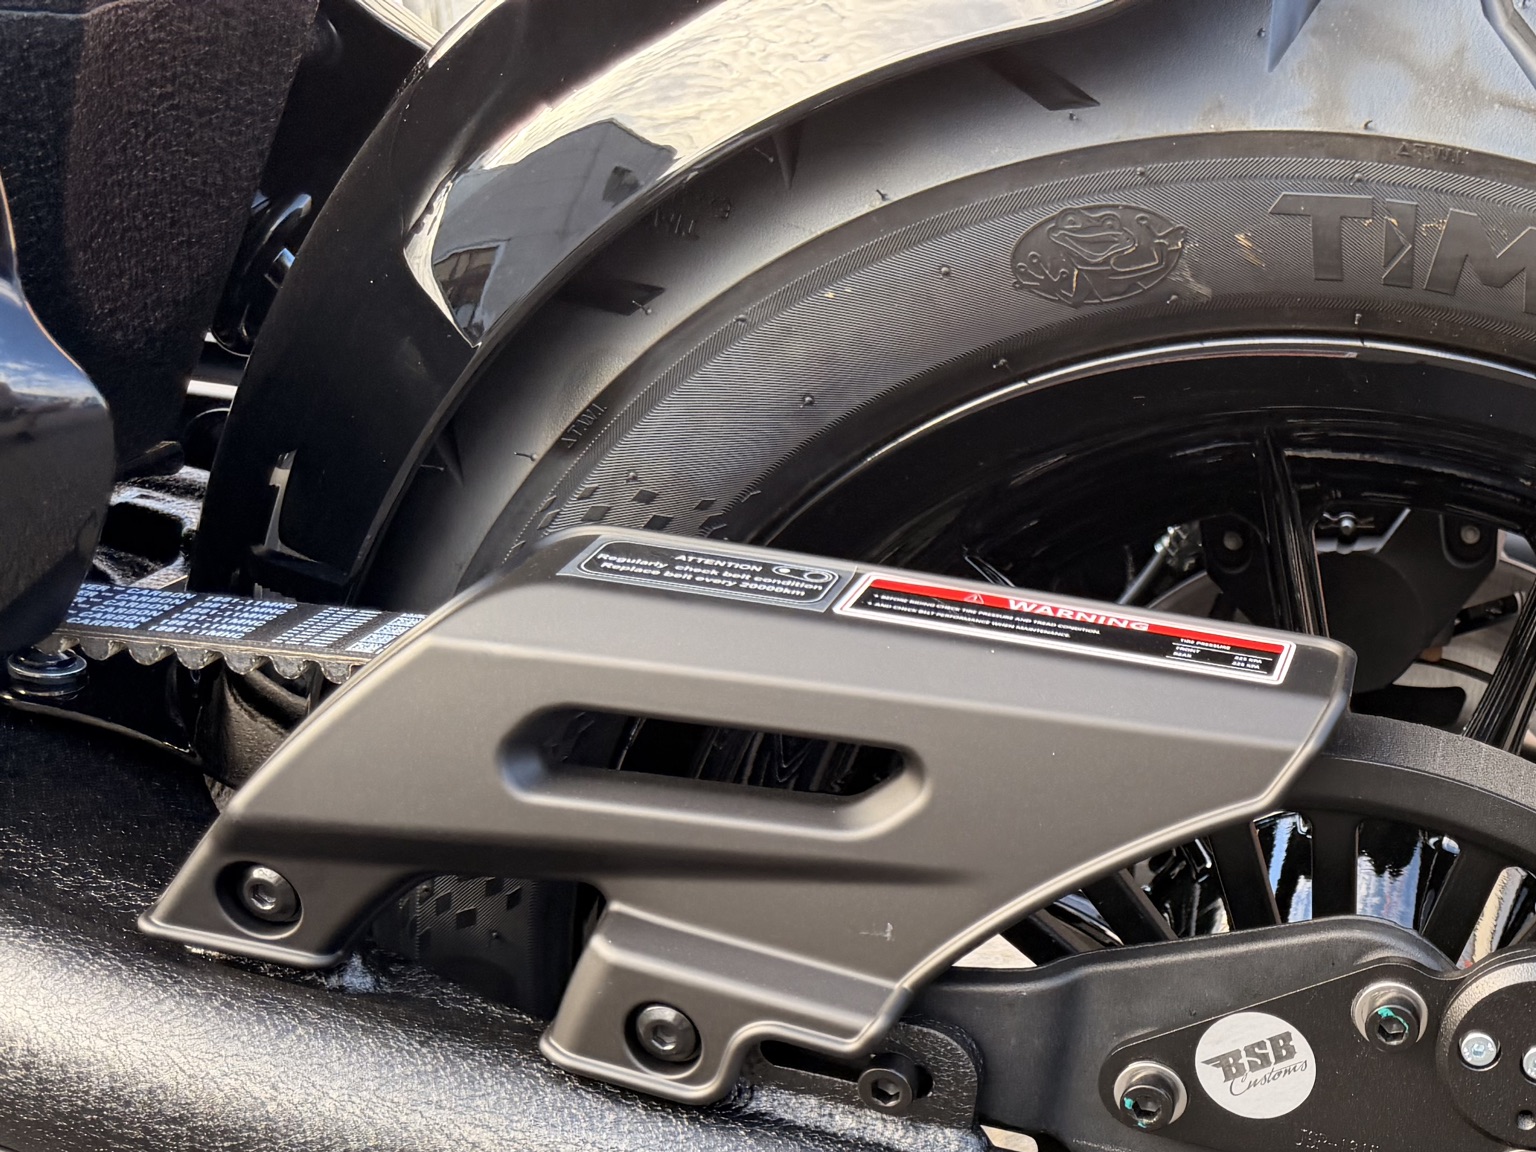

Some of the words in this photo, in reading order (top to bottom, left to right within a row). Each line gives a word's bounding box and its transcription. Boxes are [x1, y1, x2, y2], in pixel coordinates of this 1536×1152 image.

[597, 553, 668, 568] Regularly
[674, 565, 719, 576] check
[722, 571, 751, 581] belt
[754, 576, 823, 591] condition
[674, 555, 762, 572] ATTENTION
[600, 562, 661, 575] Replace
[663, 570, 693, 580] belt
[695, 576, 737, 587] every
[739, 582, 806, 597] 20000km
[114, 594, 186, 605] CARBON
[126, 588, 197, 599] CARBON
[91, 605, 164, 617] CARBON
[102, 600, 176, 611] CARBON
[66, 617, 141, 630] CARBON
[78, 611, 152, 623] CARBON
[892, 605, 917, 613] CHECK
[936, 612, 990, 625] PERFORMANCE
[992, 621, 1015, 630] WHEN
[936, 603, 961, 612] CHECK
[978, 610, 1014, 621] PRESSURE
[1014, 616, 1032, 624] AND
[1033, 619, 1057, 628] TREAD
[1008, 599, 1150, 631] WARNING
[1196, 640, 1231, 650] PRESSURE
[1201, 1031, 1297, 1083] BSB
[1230, 1059, 1308, 1096] Customs
